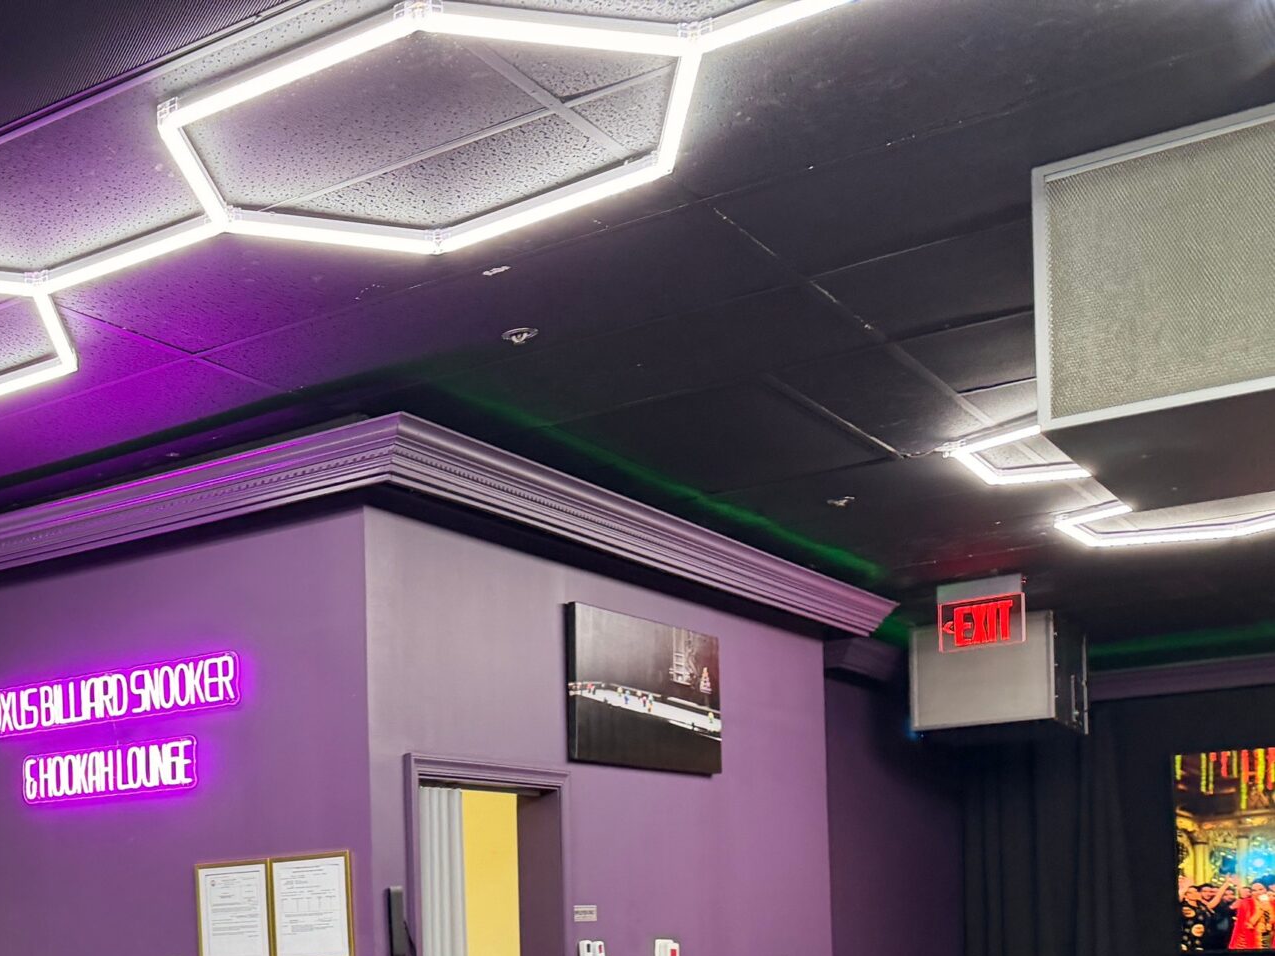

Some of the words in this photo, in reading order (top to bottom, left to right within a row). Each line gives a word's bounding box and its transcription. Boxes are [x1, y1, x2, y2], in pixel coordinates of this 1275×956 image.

[954, 600, 1013, 647] EXIT
[40, 673, 129, 728] BILLIARD
[130, 655, 236, 714] SNOOKER
[39, 748, 115, 798] HOOKAH
[117, 739, 193, 791] LOUNGE
